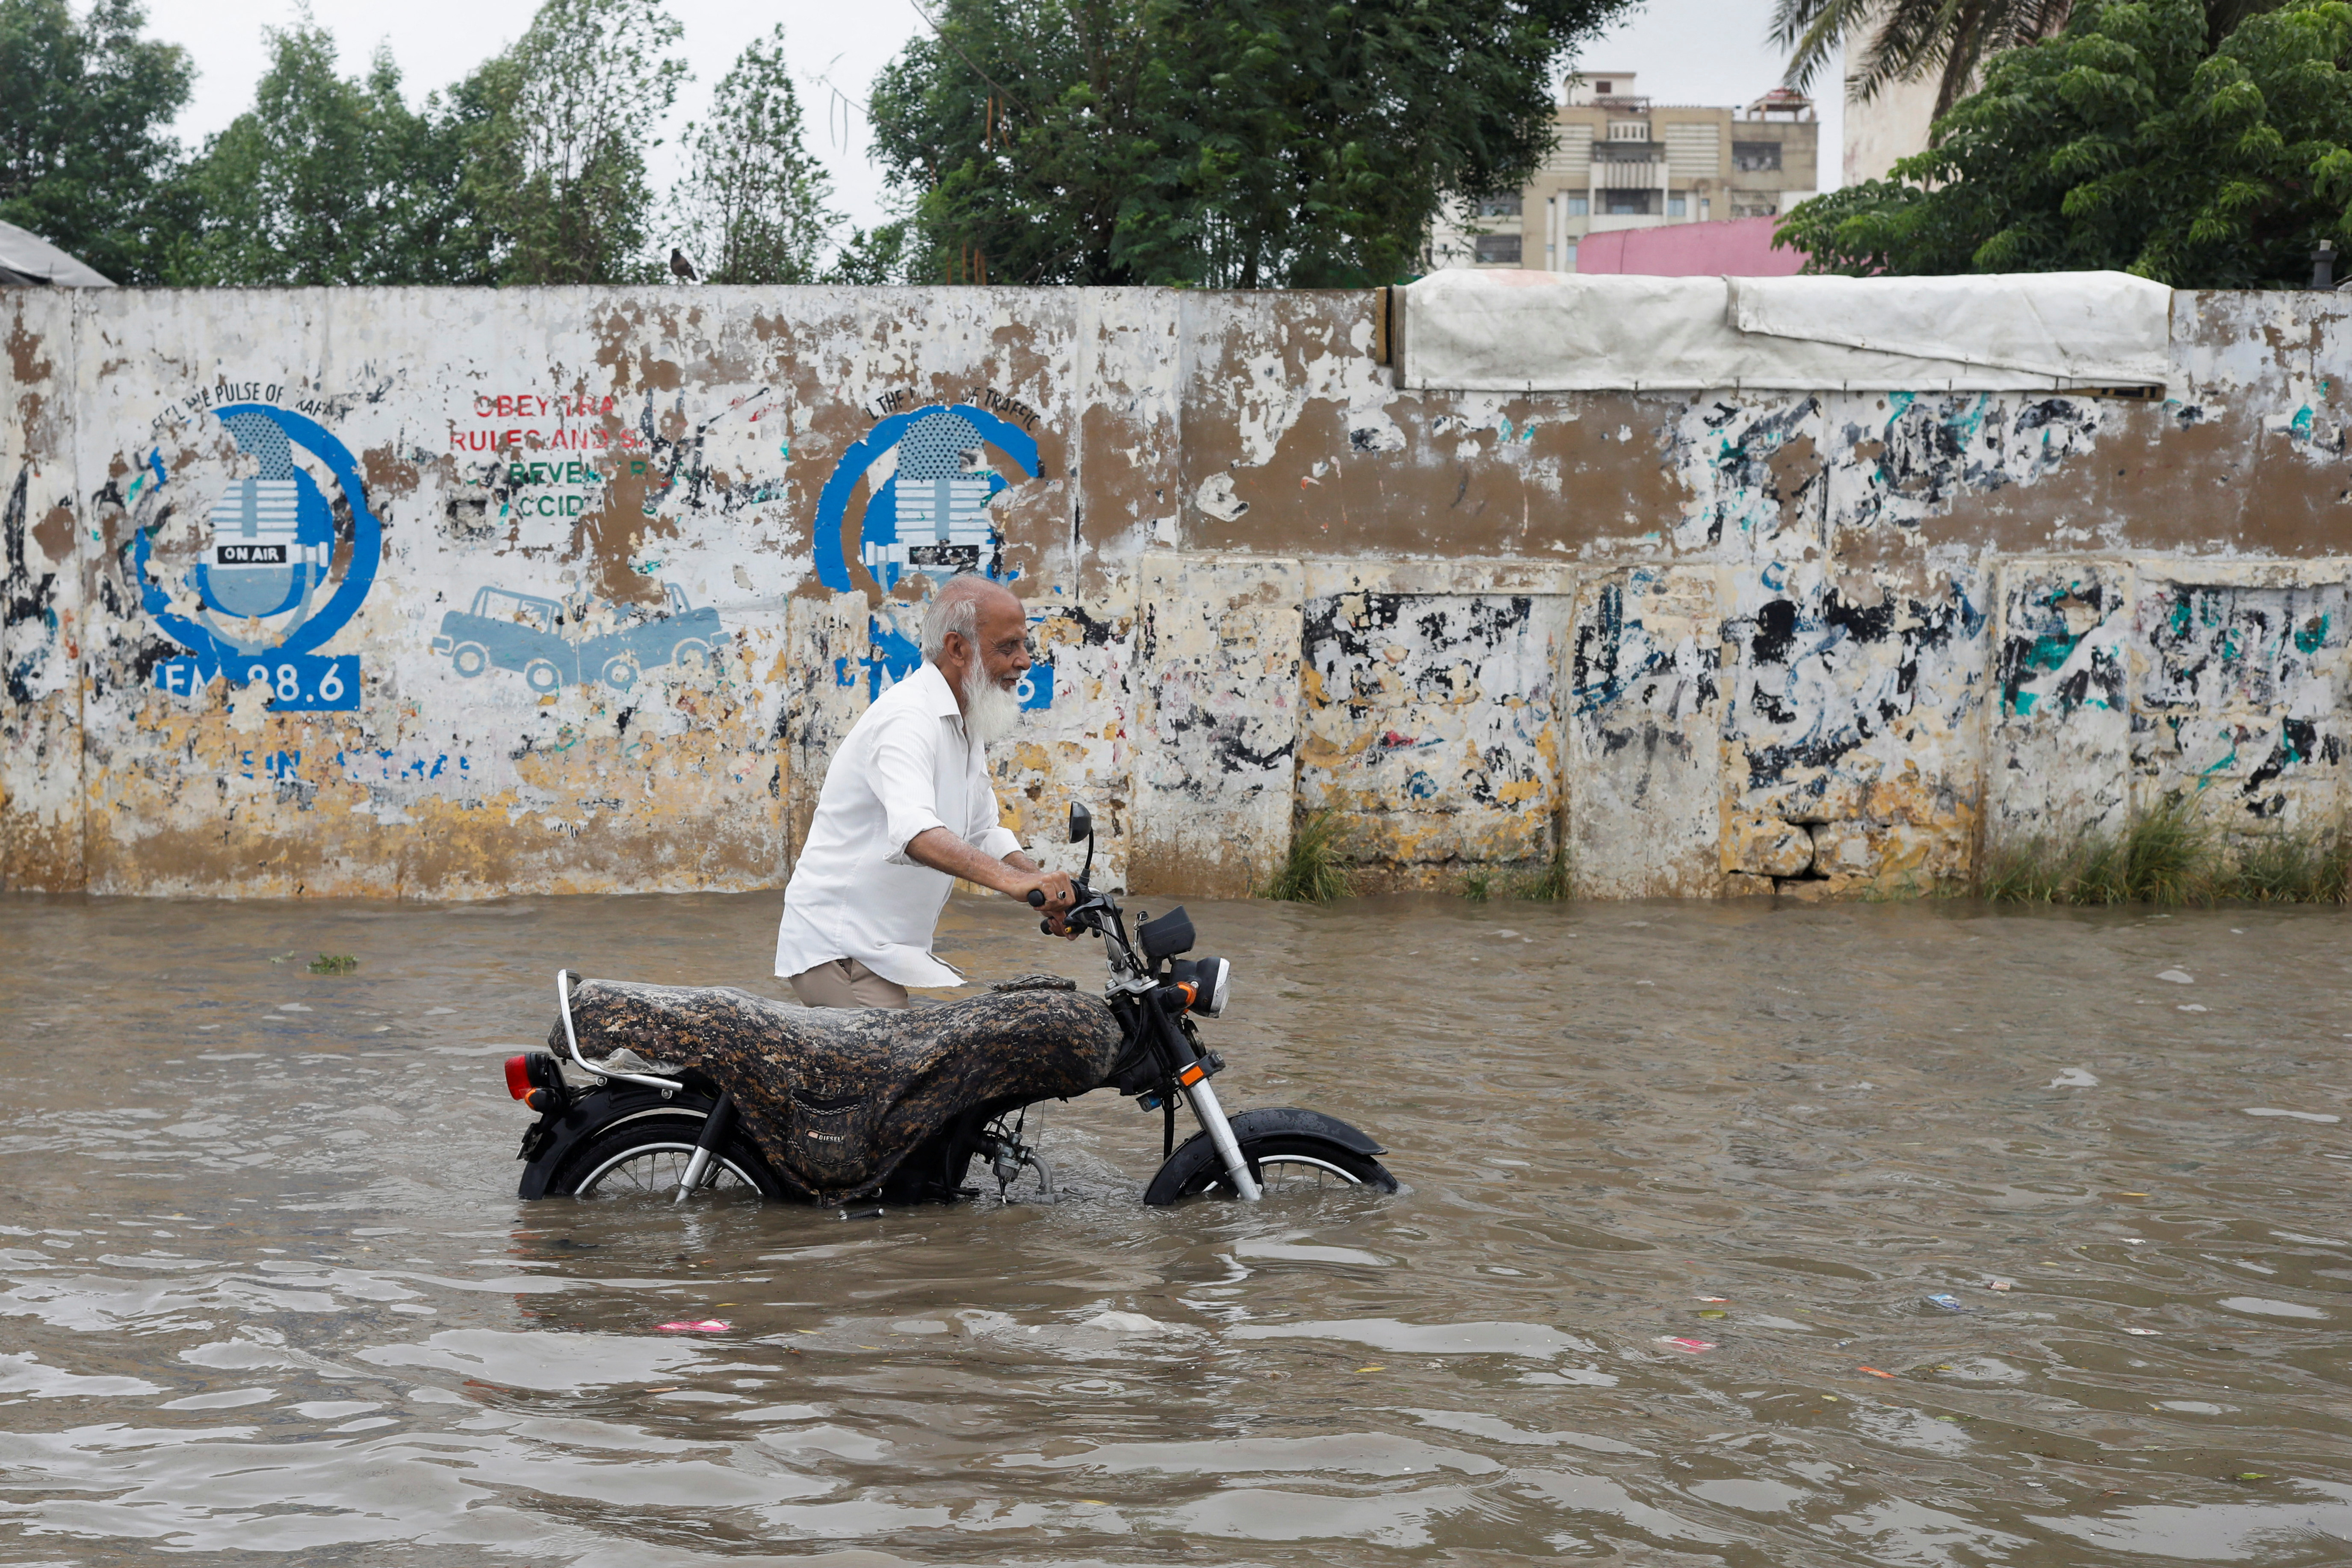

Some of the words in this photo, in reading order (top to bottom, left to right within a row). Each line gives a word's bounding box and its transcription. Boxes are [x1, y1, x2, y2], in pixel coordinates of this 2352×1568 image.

[216, 383, 260, 403] PULSE
[473, 395, 552, 417] OBEY
[984, 389, 1041, 431] TRAFFIC
[550, 429, 609, 450] AND
[225, 547, 248, 560] ON
[251, 547, 279, 561] AIR
